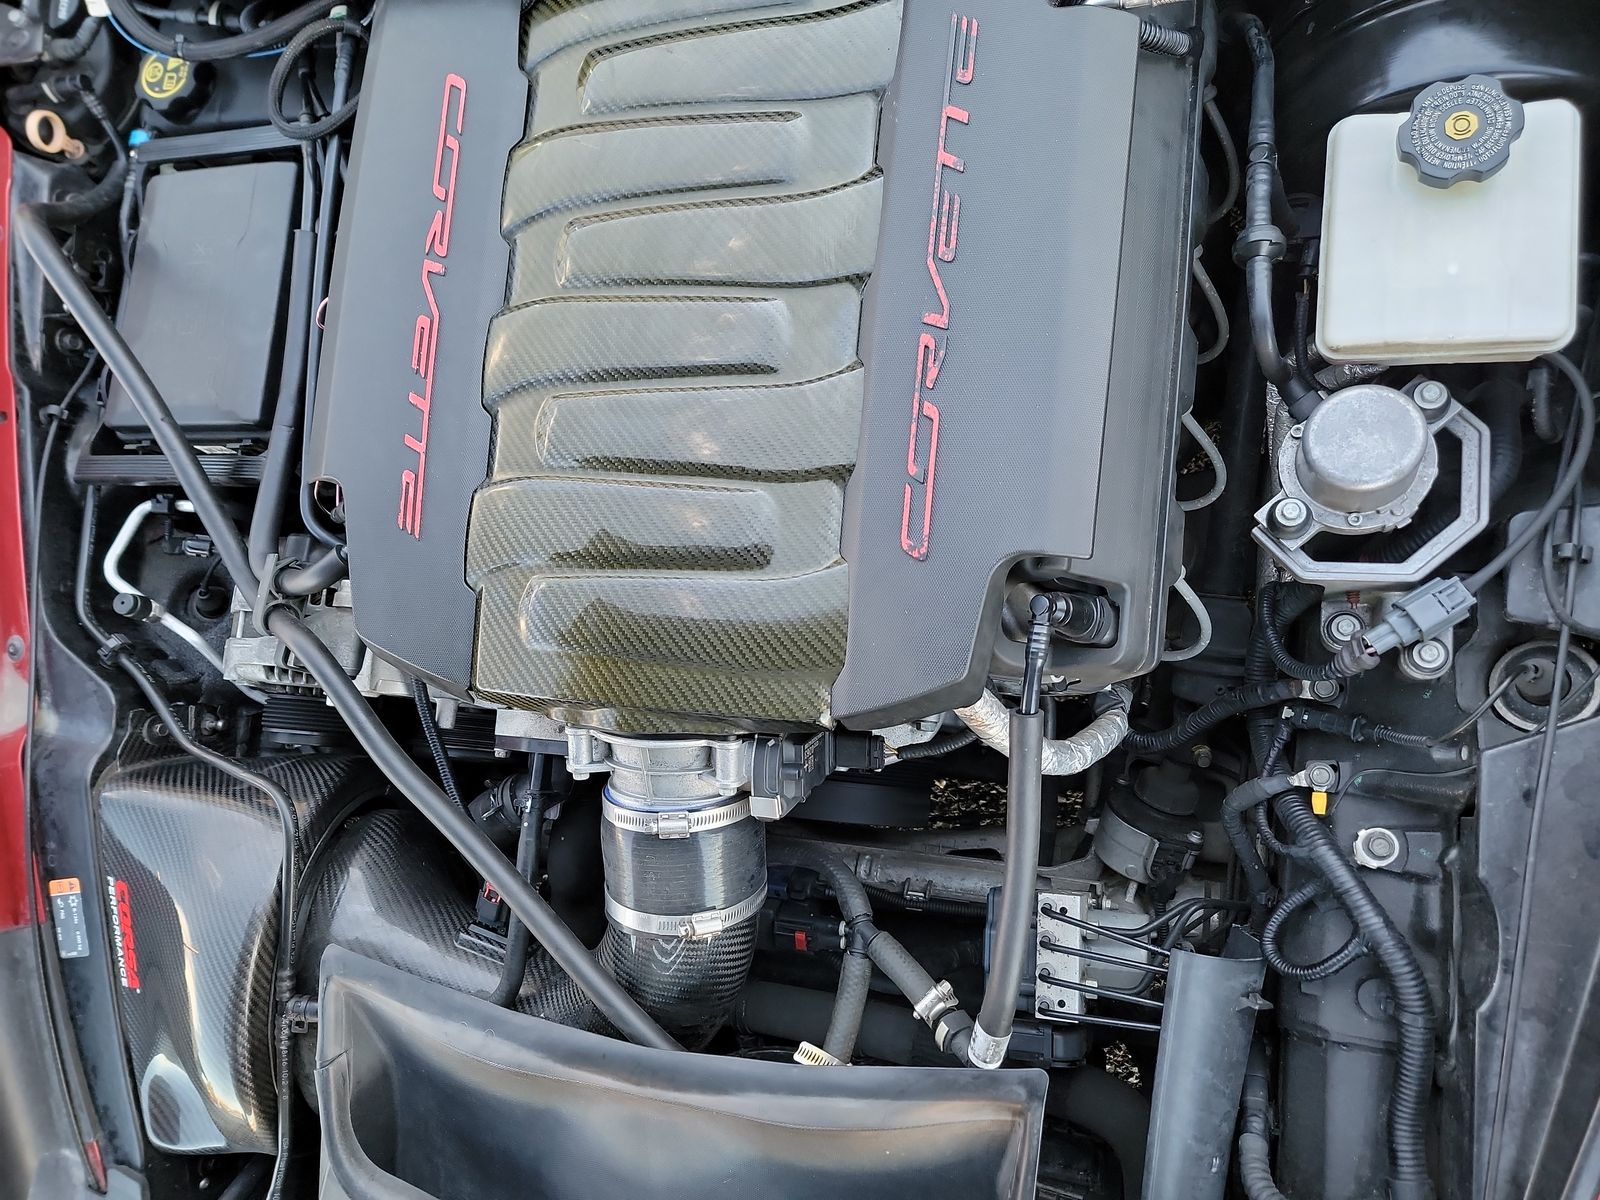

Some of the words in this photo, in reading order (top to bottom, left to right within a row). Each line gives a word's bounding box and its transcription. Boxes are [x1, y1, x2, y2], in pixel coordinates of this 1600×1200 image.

[397, 72, 469, 540] CORVETTE
[900, 9, 980, 561] CORVETTE
[107, 876, 129, 988] PERFORMANCE
